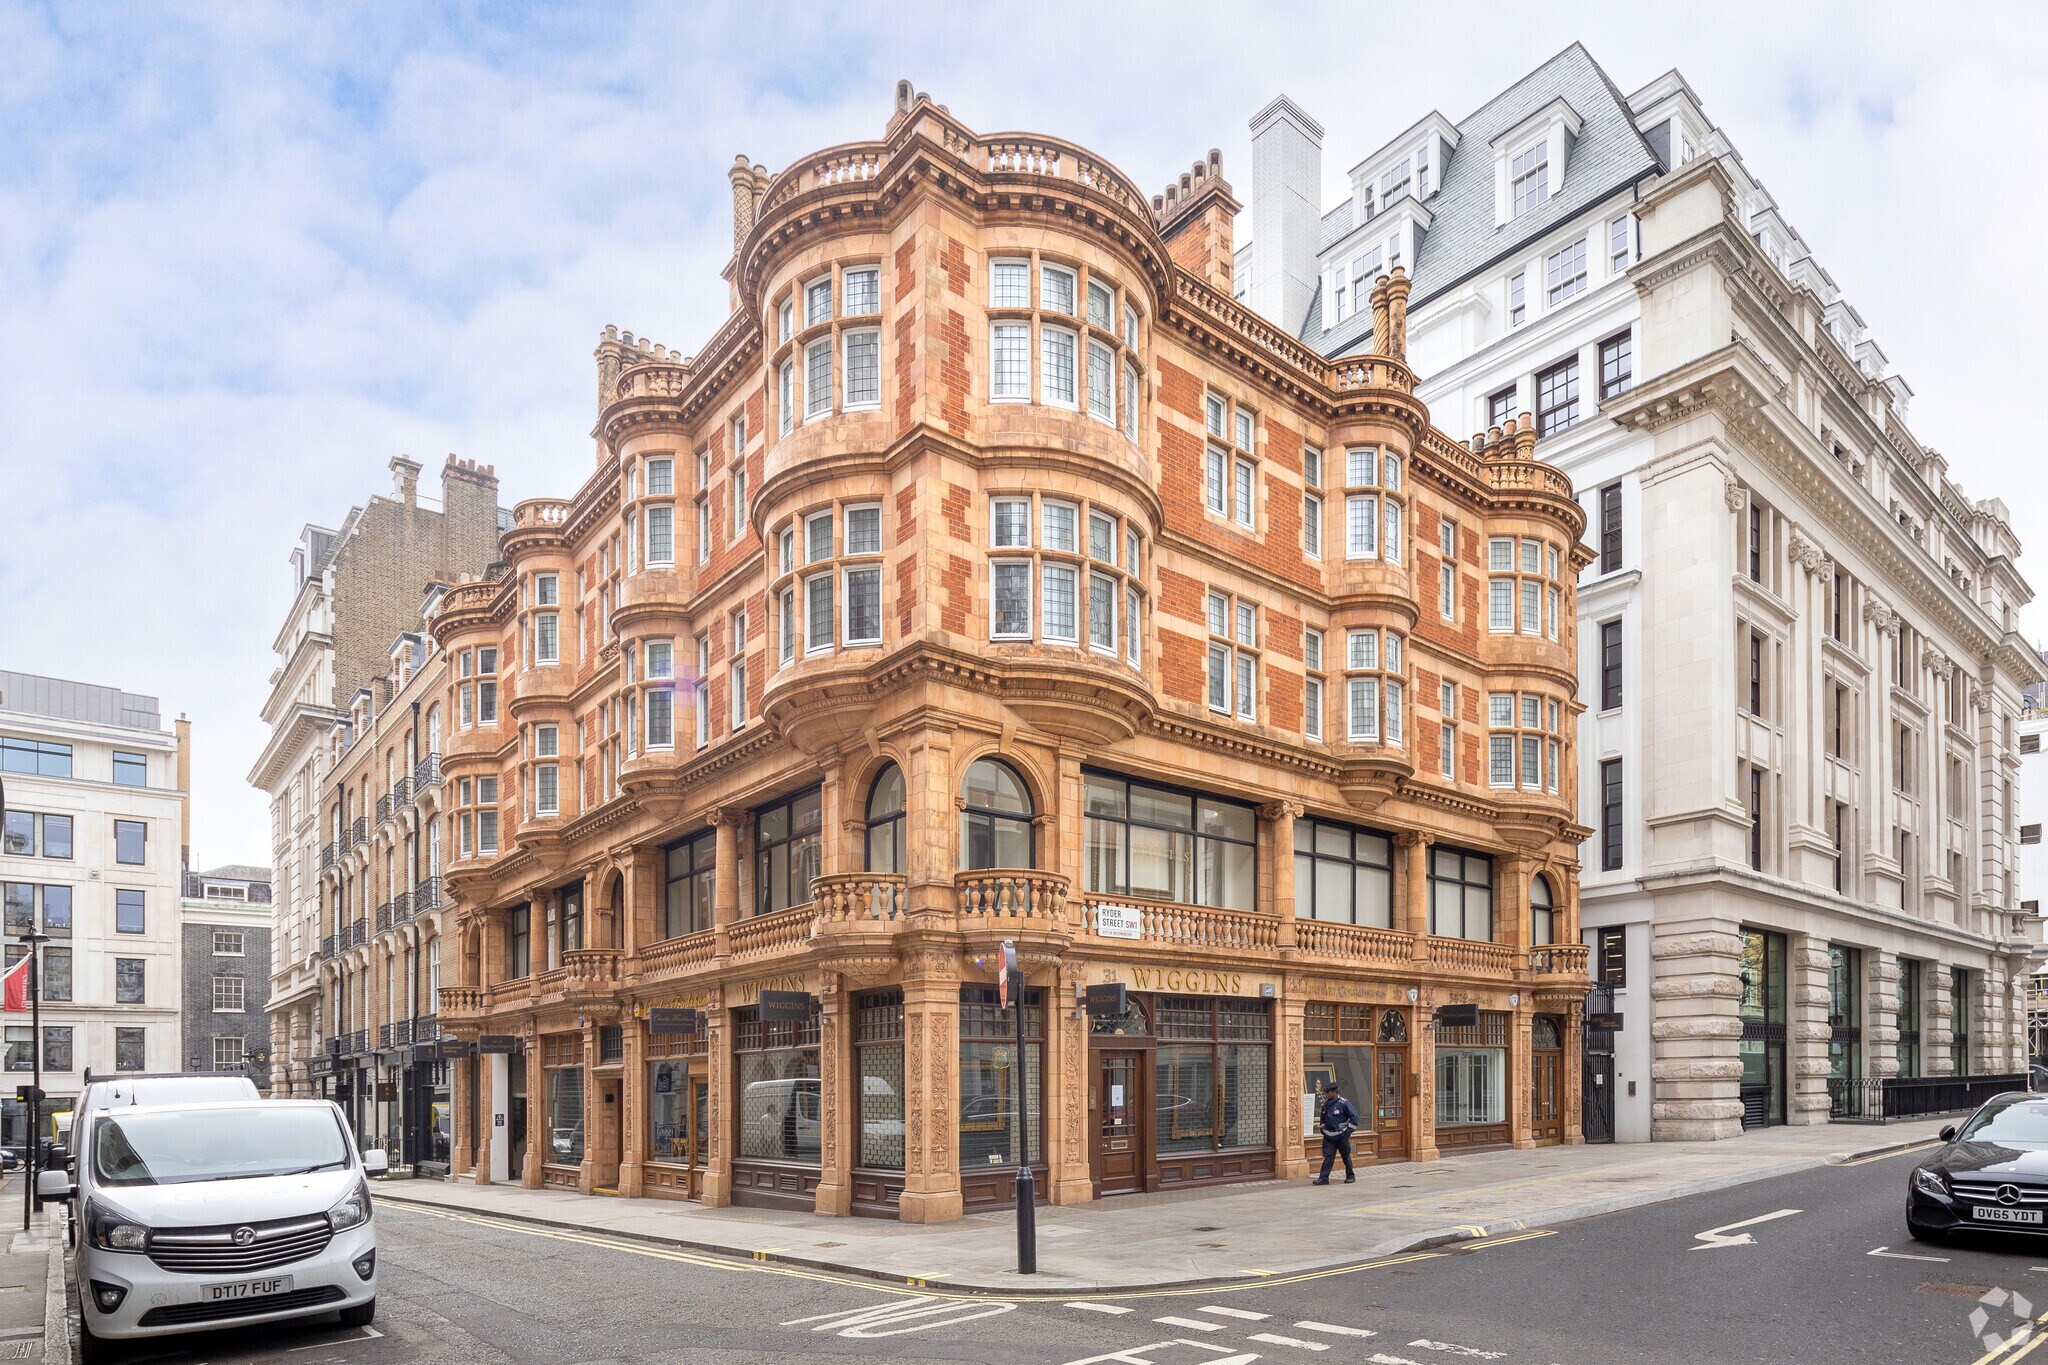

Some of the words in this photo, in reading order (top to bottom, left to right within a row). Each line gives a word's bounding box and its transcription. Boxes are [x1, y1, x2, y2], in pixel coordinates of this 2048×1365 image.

[1102, 909, 1121, 918] RYDER
[1102, 918, 1124, 928] STREET
[1125, 920, 1138, 929] SW1
[1103, 968, 1117, 983] 31
[1132, 967, 1241, 993] WIGGINS
[1089, 994, 1117, 1004] WIGGINS
[768, 1001, 805, 1010] WIGGINS
[1977, 1208, 2009, 1220] OV65
[2012, 1211, 2037, 1222] YDT
[213, 1284, 247, 1299] DT17
[252, 1280, 281, 1294] FUF
